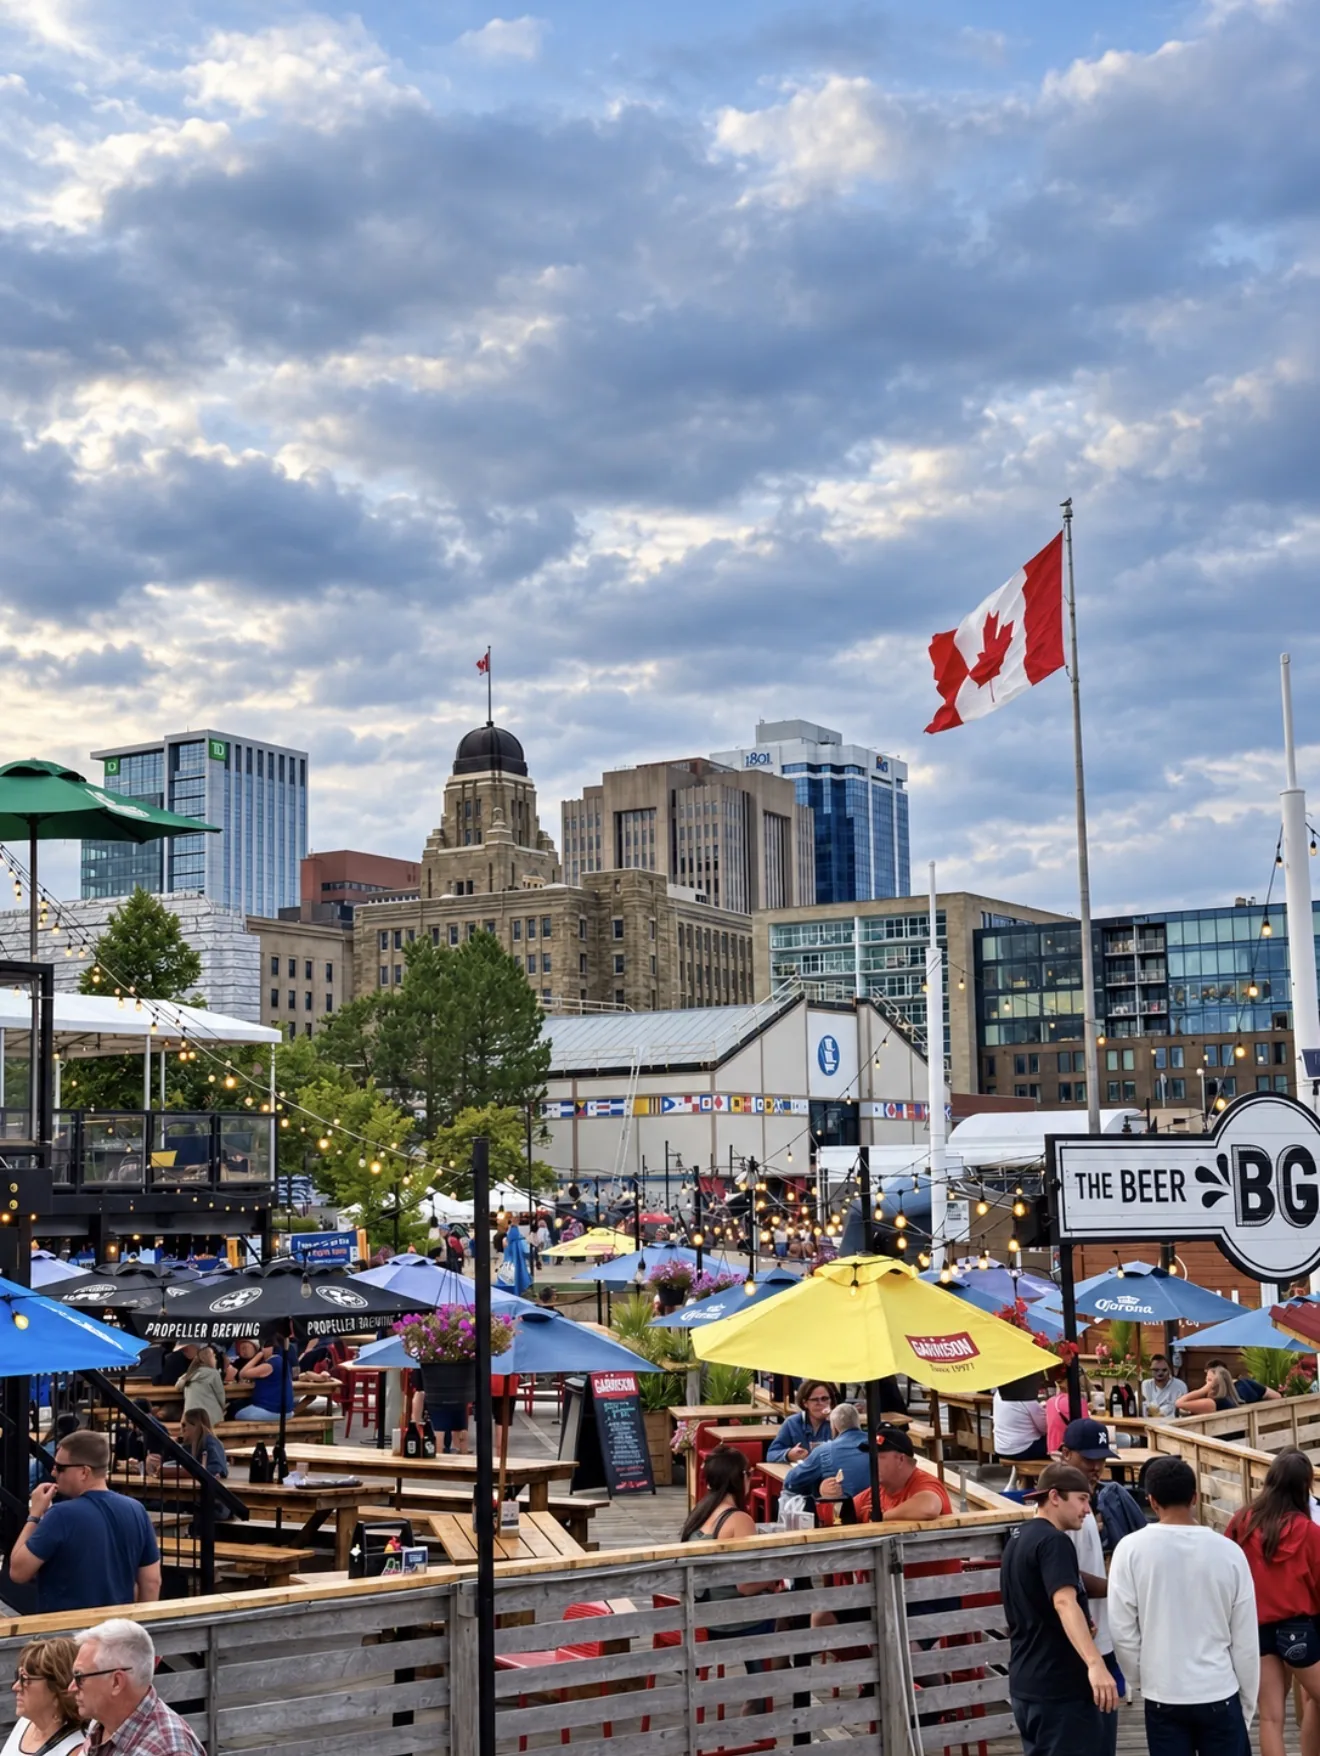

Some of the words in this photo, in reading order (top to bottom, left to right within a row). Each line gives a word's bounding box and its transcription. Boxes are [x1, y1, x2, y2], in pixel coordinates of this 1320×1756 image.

[212, 742, 224, 756] TD
[1074, 1172, 1113, 1200] THE
[1120, 1169, 1187, 1203] BEER
[1231, 1144, 1319, 1229] BG
[144, 1322, 208, 1338] PROPELLER
[211, 1322, 261, 1338] BREWING
[307, 1318, 356, 1336] PROPELLER
